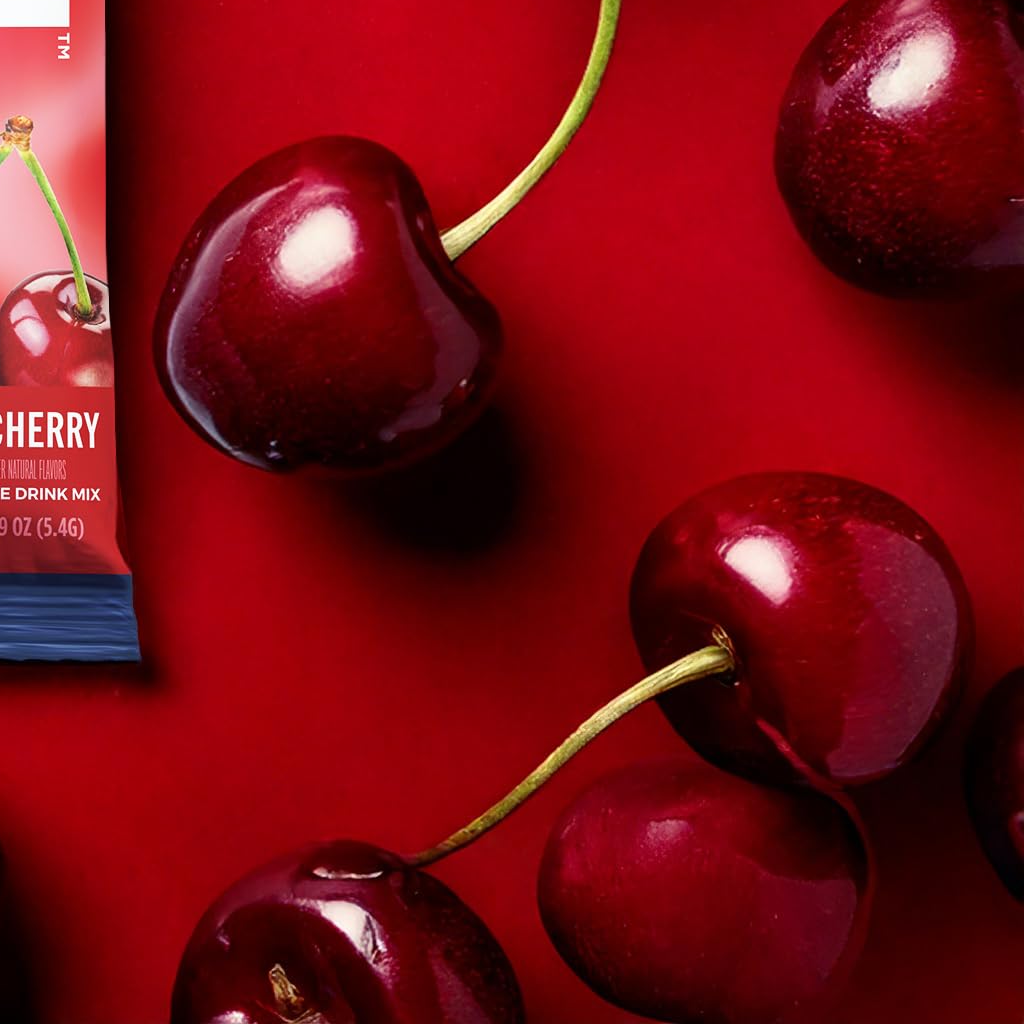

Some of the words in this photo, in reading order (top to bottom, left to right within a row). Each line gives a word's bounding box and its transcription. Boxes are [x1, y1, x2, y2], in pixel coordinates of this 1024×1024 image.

[7, 459, 37, 480] NATURAL
[38, 459, 67, 480] FLAVORS
[15, 487, 68, 501] DRINK
[72, 488, 101, 502] MIX
[13, 517, 32, 537] OZ
[36, 517, 85, 540] (5.4G)
